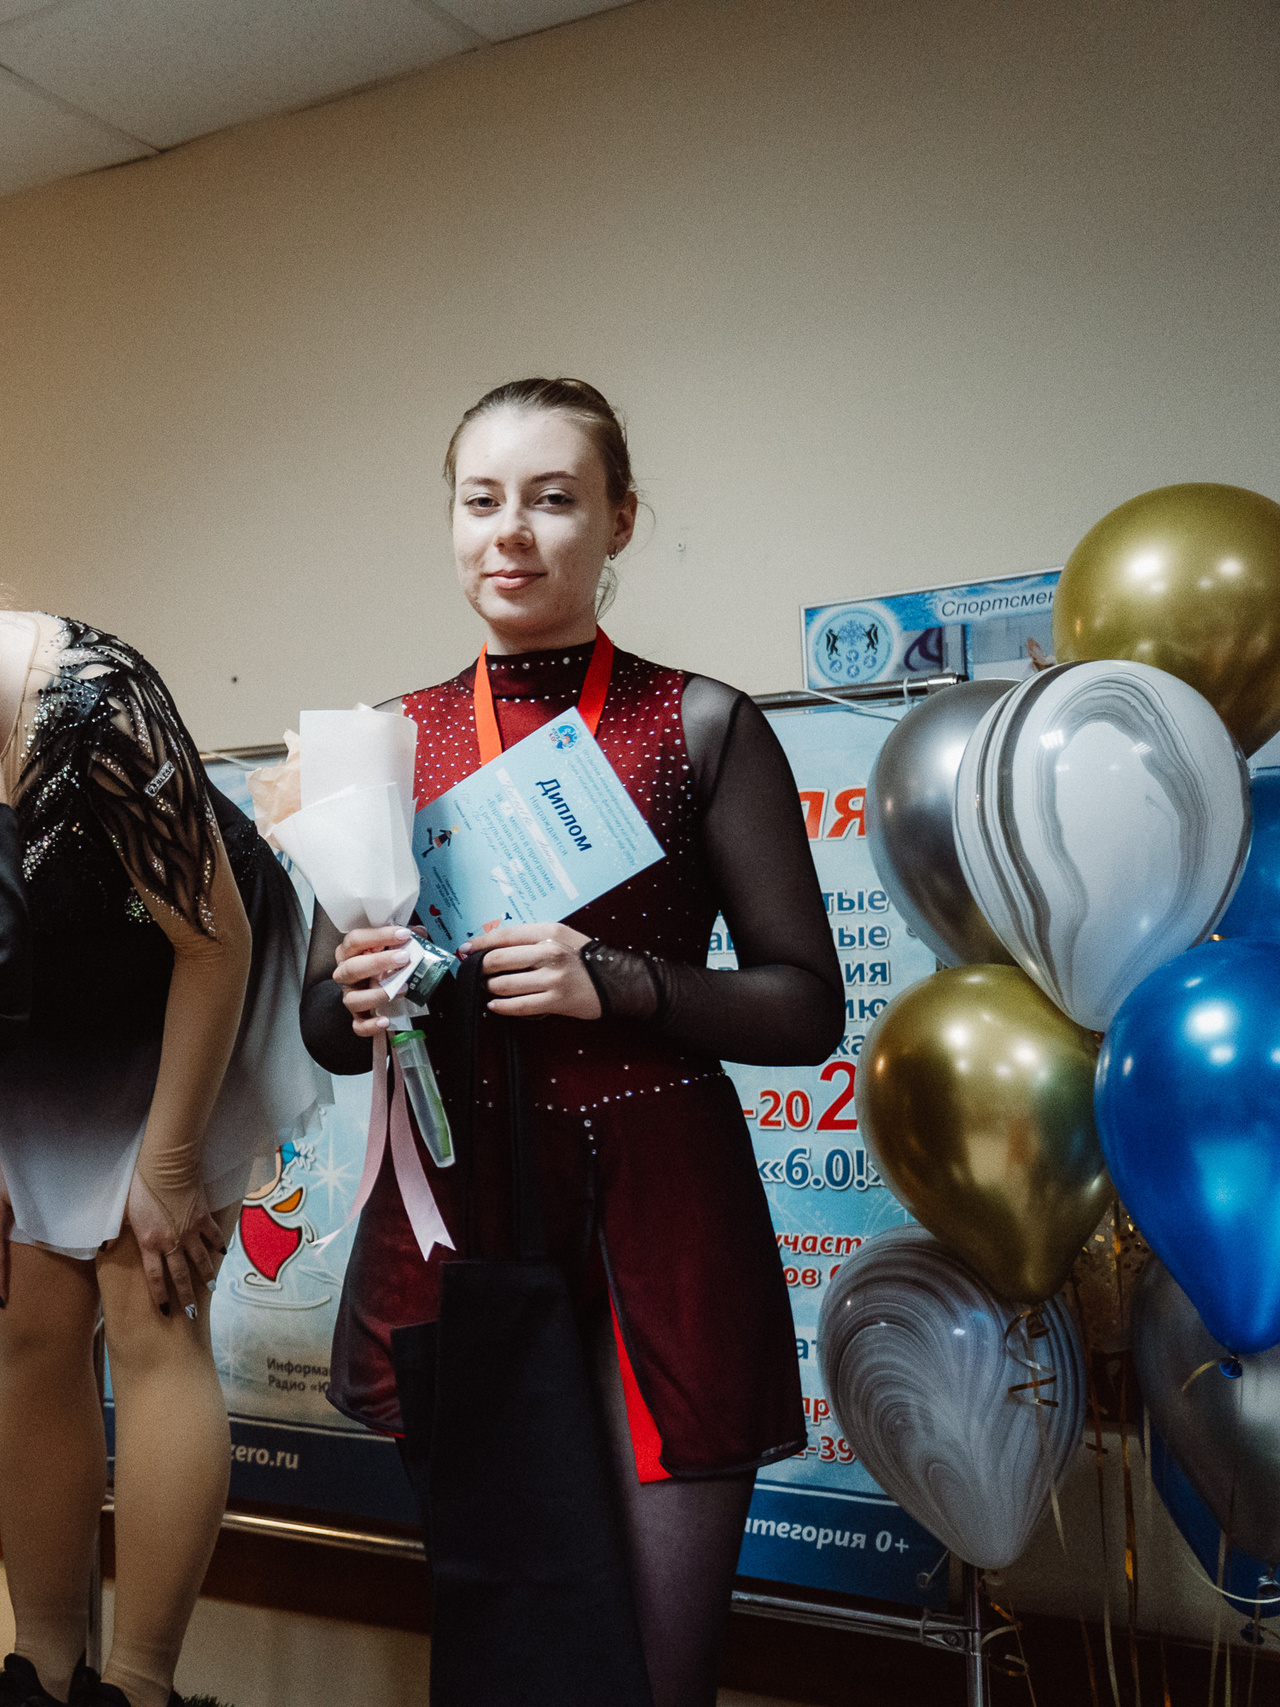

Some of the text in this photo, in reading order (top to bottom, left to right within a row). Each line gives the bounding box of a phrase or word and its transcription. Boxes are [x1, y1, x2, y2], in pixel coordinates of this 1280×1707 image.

[480, 811, 513, 861] результатом
[527, 794, 569, 856] Награждается
[535, 778, 593, 852] Диплом
[508, 815, 526, 840] место
[525, 846, 556, 892] программе
[832, 926, 887, 947] ые
[268, 1375, 306, 1392] Радио
[875, 1530, 910, 1554] 0+
